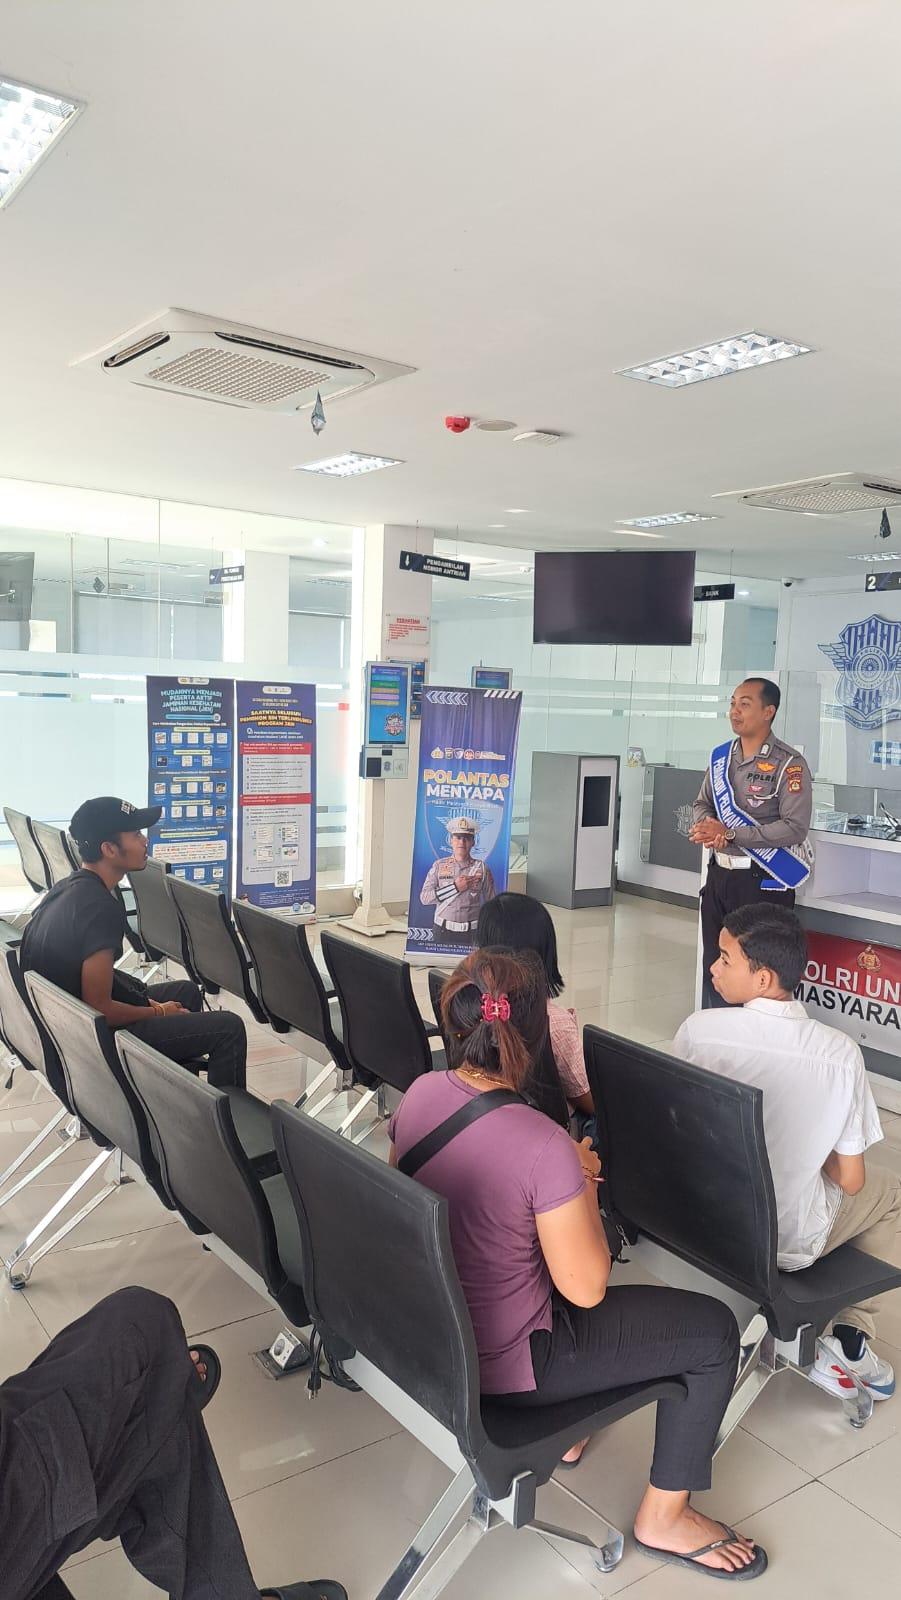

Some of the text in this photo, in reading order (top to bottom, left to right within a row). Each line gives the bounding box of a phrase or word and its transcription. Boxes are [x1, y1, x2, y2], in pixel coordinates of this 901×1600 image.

[867, 575, 877, 590] 2
[423, 768, 510, 788] POLANTAS
[746, 772, 777, 782] POLRI
[426, 783, 505, 801] MENYAPA
[804, 960, 859, 992] OLRI
